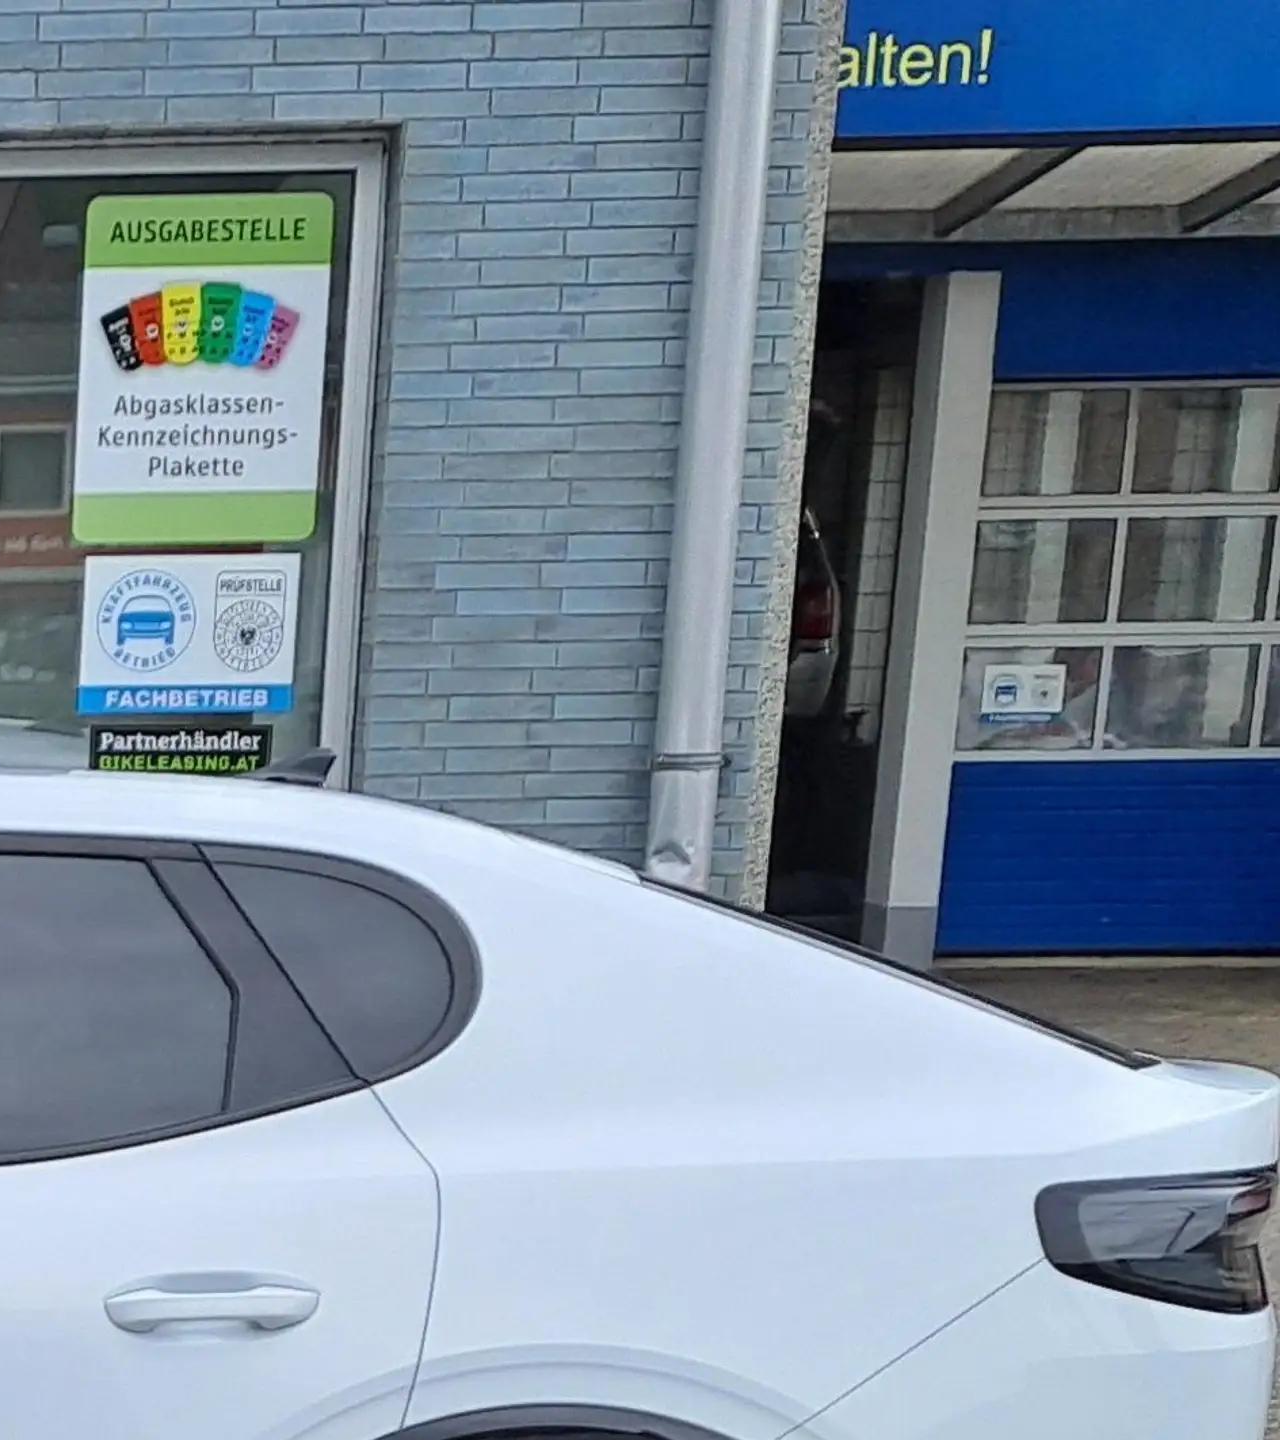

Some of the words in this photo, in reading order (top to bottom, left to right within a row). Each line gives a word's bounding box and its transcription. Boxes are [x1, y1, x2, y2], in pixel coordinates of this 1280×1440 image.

[109, 217, 307, 243] AUSGABESTELLE
[113, 394, 284, 420] Abgasklassen-
[97, 424, 298, 449] Kennzeichnungs-
[148, 456, 245, 478] Plakette
[100, 574, 192, 624] KRAFTFAHRZEUG
[105, 689, 269, 708] FACHBETRIEB
[99, 728, 262, 751] Partnerhändler
[98, 754, 260, 772] BIKELEASING.AT
